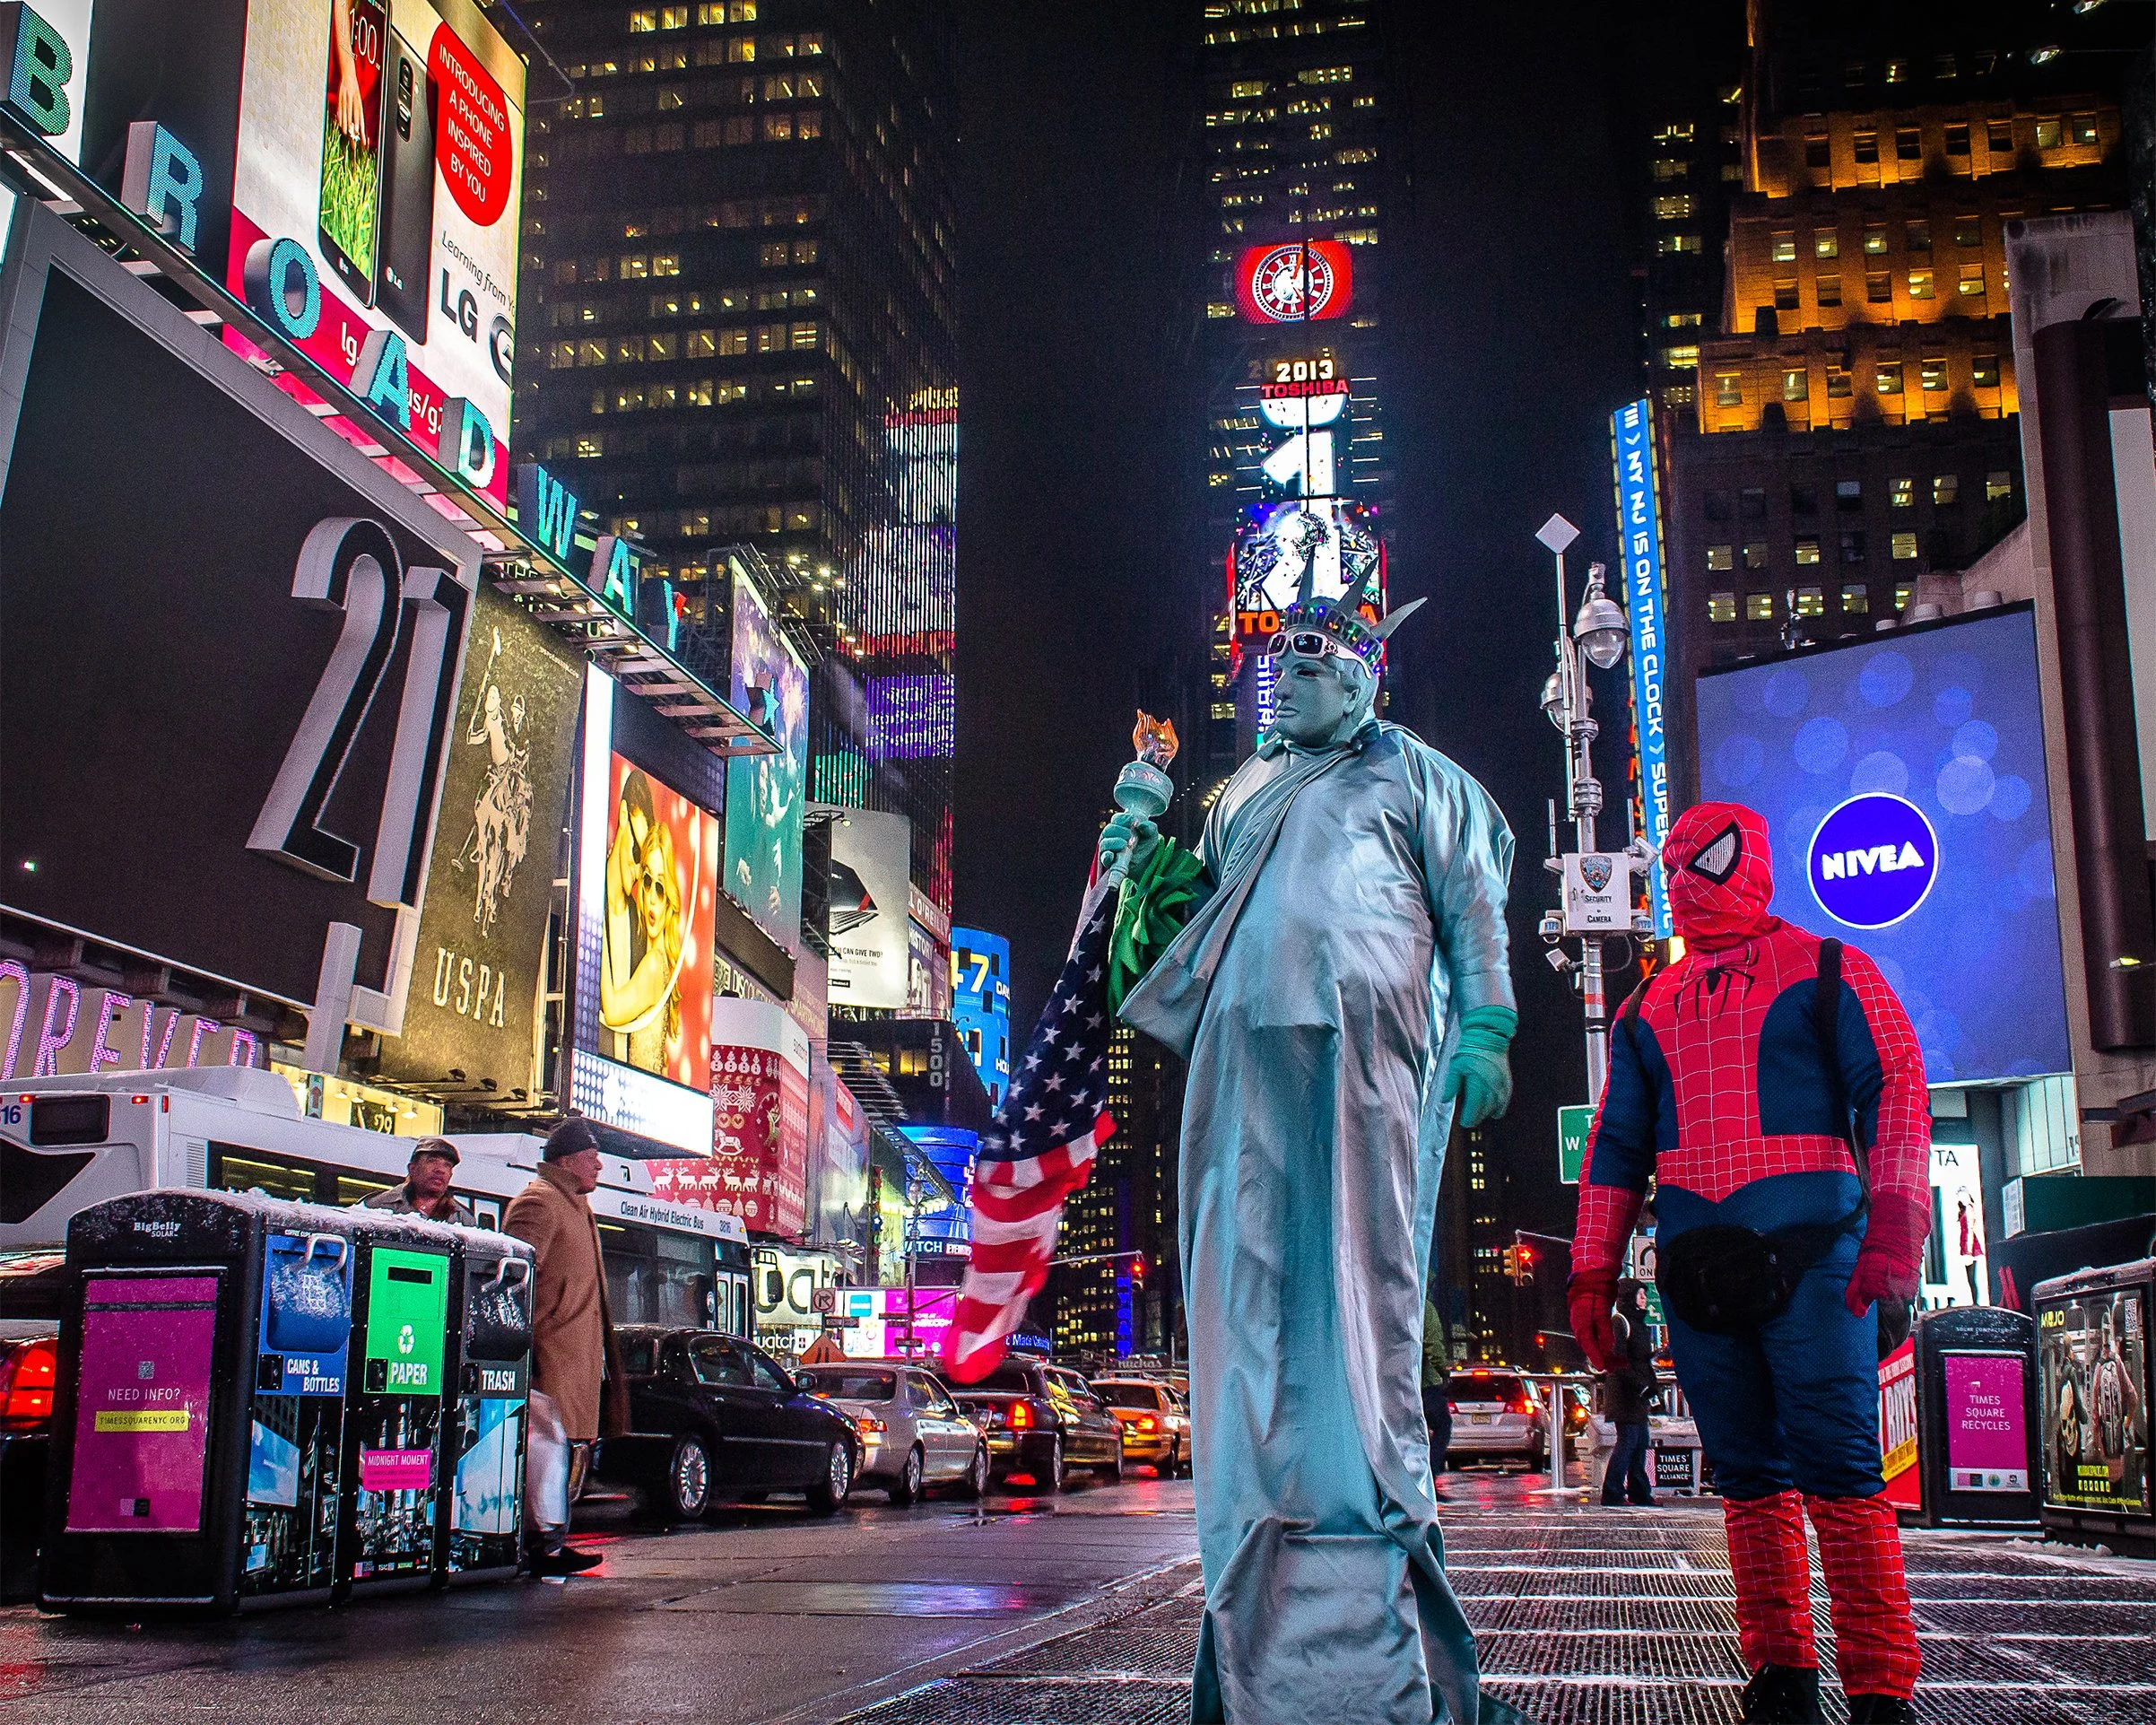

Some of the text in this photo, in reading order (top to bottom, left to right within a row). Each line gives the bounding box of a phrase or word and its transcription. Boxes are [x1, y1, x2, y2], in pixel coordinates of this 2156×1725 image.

[439, 44, 504, 132] INTRODUCING
[449, 90, 492, 150] A PHONE
[448, 118, 491, 177] INSPIRED
[451, 153, 486, 203] BY YOU
[442, 231, 482, 286] Learning
[482, 274, 507, 306] from
[440, 267, 478, 344] LG
[1276, 360, 1334, 382] 2013
[1260, 378, 1349, 398] TOSHIBA
[1627, 450, 1644, 484] NY
[1630, 491, 1647, 525] NJ
[1632, 531, 1649, 556] IS
[1635, 559, 1653, 597] ON
[1639, 598, 1656, 651] THE
[1642, 654, 1664, 737] CLOCK
[247, 517, 470, 909] 21
[1821, 841, 1925, 881] NIVEA
[1585, 894, 1613, 903] SECURITY
[1587, 915, 1612, 923] CAMERA
[855, 948, 867, 957] GIVE
[433, 946, 504, 1029] USPA
[929, 1022, 943, 1088] 1500
[621, 1200, 704, 1230] Clean Air Hybrid Electric Bus
[134, 1222, 181, 1233] BigBelly
[287, 1358, 319, 1375] CANS &
[389, 1362, 429, 1386] PAPER
[303, 1376, 340, 1393] BOTTLES
[482, 1370, 516, 1391] TRASH
[108, 1388, 180, 1401] NEED INFO?
[1969, 1395, 2001, 1405] TIMES
[1965, 1407, 2005, 1418] SQUARE
[1961, 1420, 2011, 1431] RECYCLES
[368, 1454, 429, 1467] MIDNIGHT MOMENT
[1656, 1464, 1691, 1473] SQUARE
[1659, 1454, 1687, 1463] TIMES
